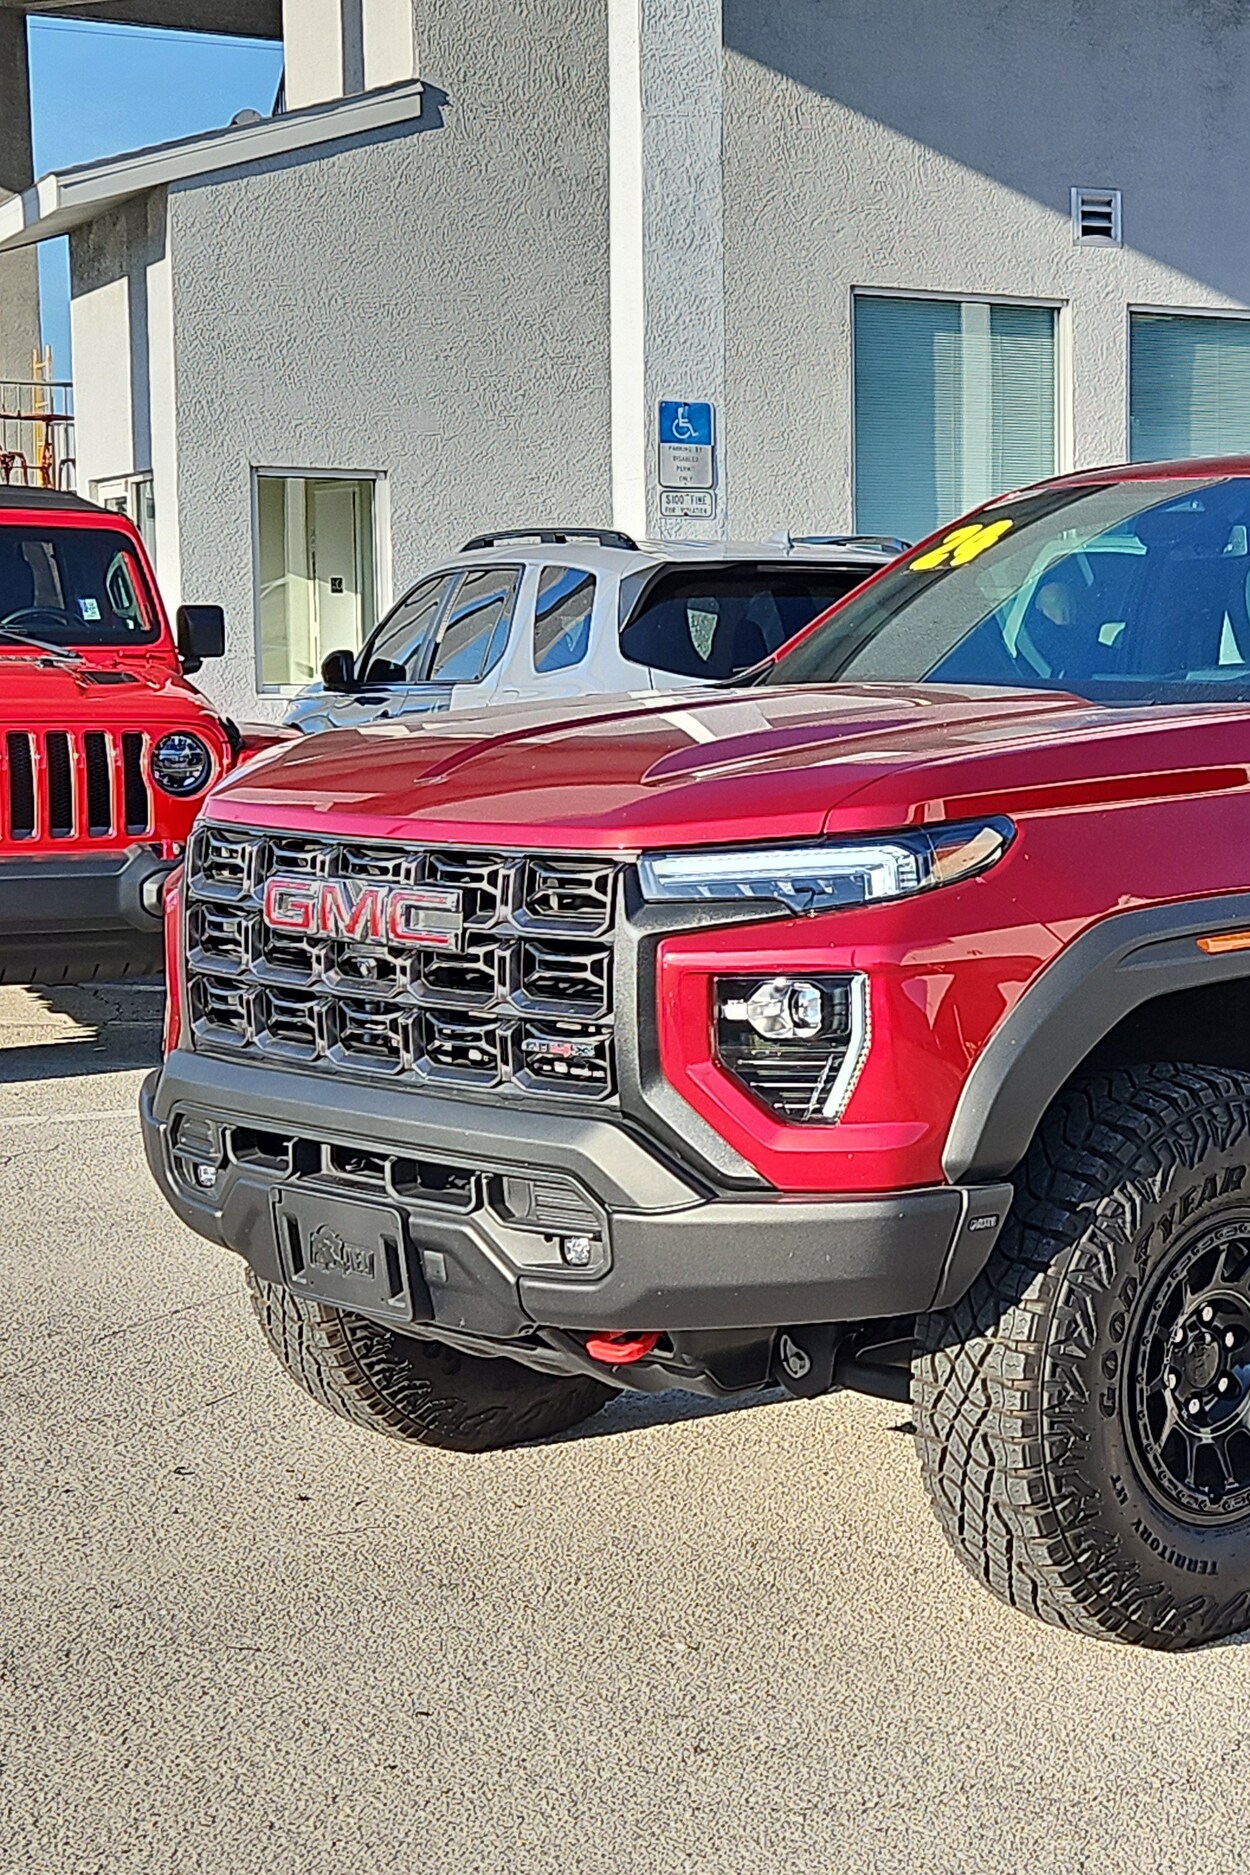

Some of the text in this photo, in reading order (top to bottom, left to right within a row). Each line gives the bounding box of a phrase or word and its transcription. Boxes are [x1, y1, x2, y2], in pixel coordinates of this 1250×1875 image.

[908, 518, 1014, 572] 24
[263, 873, 465, 953] GMC
[1099, 1163, 1248, 1420] GOODYEAR
[1130, 1517, 1219, 1575] TERRITORY
